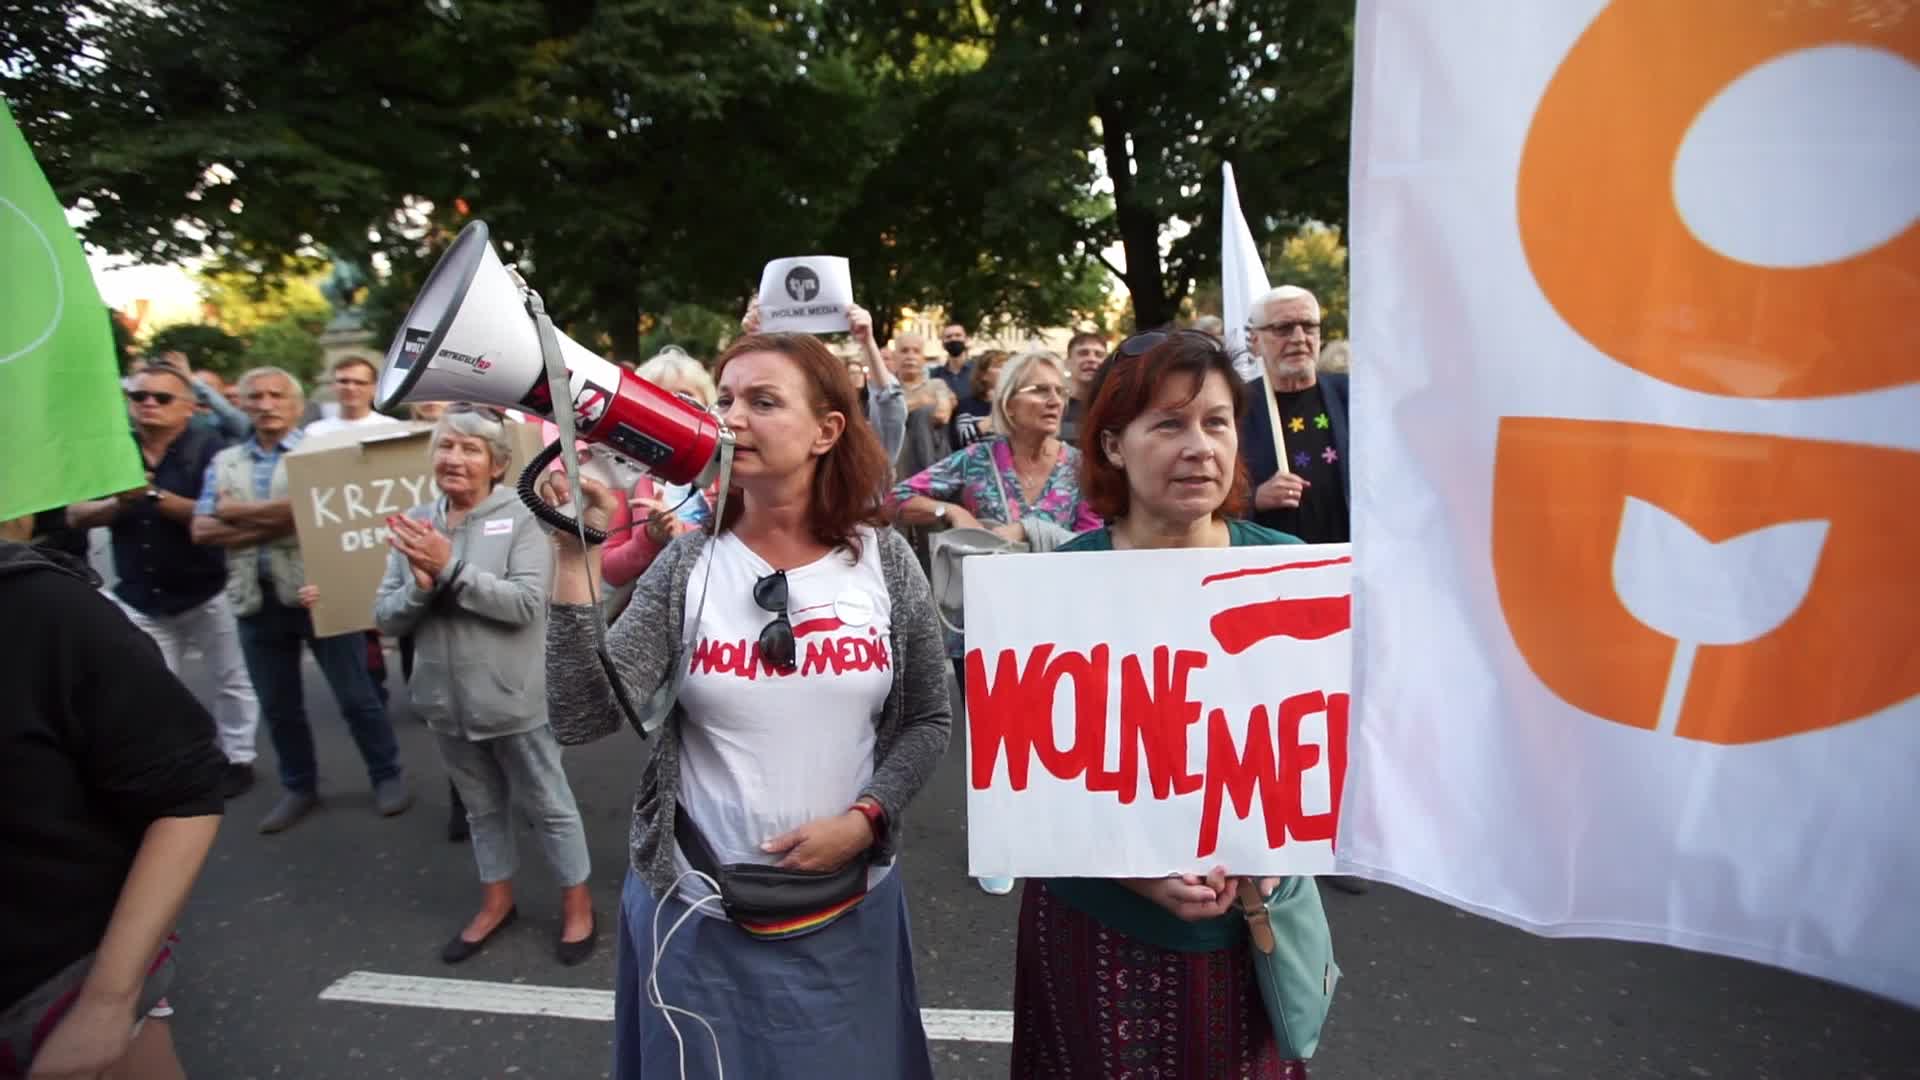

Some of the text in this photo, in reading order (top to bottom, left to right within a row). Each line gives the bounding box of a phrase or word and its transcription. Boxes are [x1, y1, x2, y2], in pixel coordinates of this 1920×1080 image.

[771, 305, 839, 318] WOLNE MEDIA
[690, 637, 797, 680] WOLN
[966, 643, 1208, 804] WOLNE
